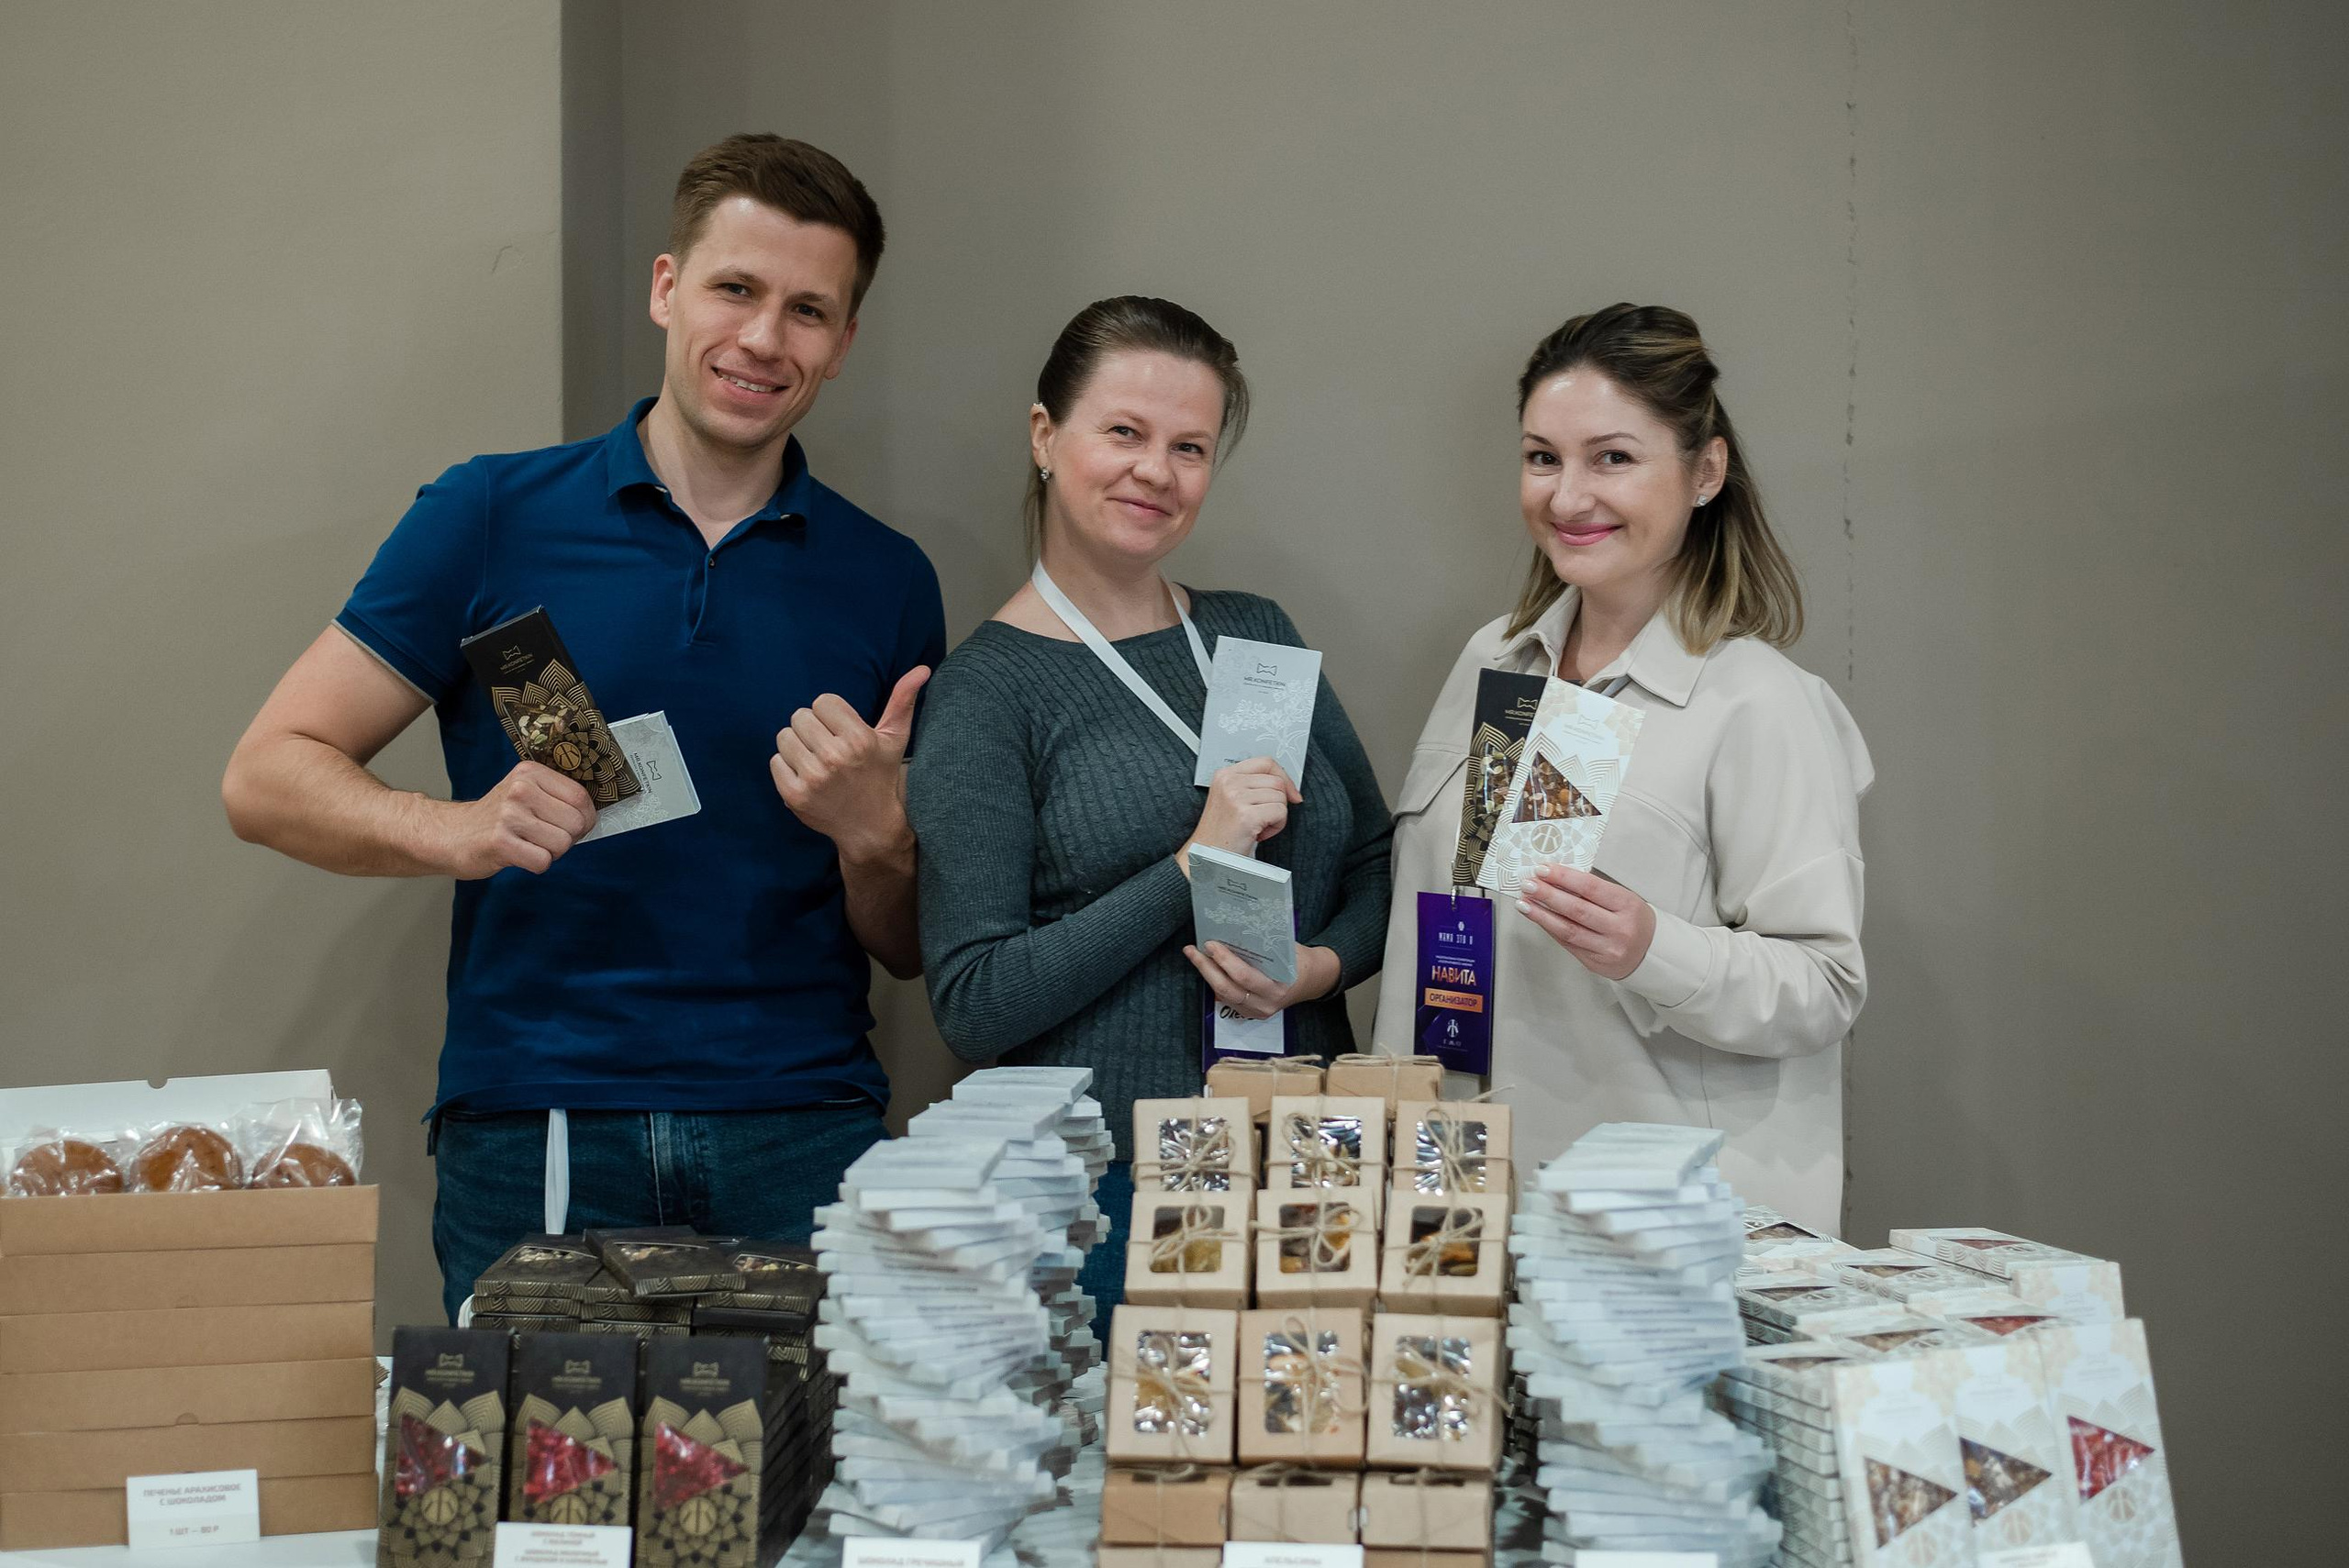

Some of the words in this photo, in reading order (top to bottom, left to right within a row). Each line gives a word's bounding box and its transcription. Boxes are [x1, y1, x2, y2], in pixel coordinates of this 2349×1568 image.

[1431, 965, 1477, 986] НАВИТА
[1430, 992, 1477, 1007] ОРГАНИЗАТОР
[143, 1486, 182, 1497] ПЕЧЕНЬЕ
[184, 1483, 241, 1495] АРАХИСОВОЕ
[167, 1494, 227, 1506] ШОКОЛАДОМ
